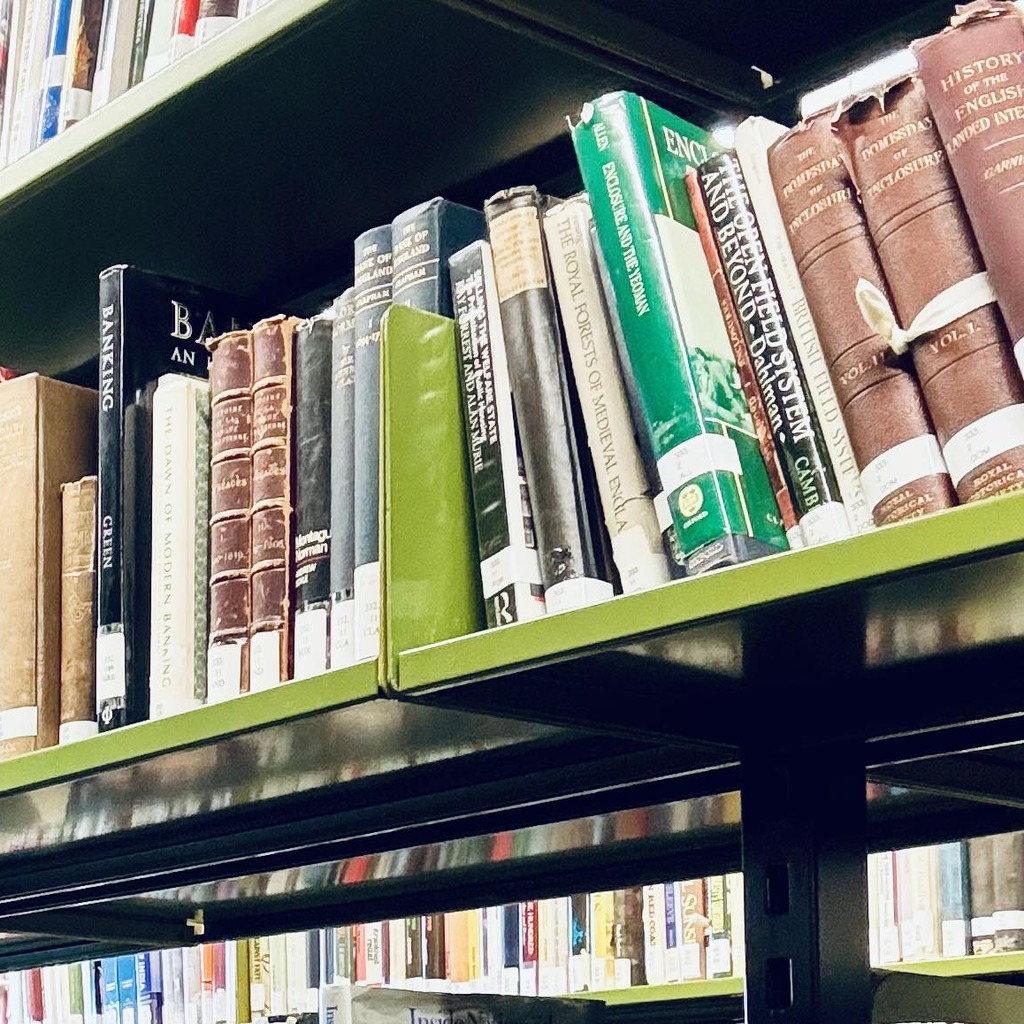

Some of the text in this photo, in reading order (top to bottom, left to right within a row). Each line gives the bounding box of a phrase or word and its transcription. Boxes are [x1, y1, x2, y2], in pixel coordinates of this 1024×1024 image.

[940, 51, 1023, 92] HISTORY
[964, 73, 1009, 95] OF THE
[861, 116, 933, 162] DOMESDAY
[880, 109, 900, 126] THE
[945, 116, 991, 153] LANDED
[867, 150, 943, 198] INCLOSURE
[873, 147, 889, 160] OF
[414, 229, 429, 241] OF
[592, 121, 651, 316] ALLEN ENCLOSURE AND THE YEOMAN
[377, 251, 392, 265] OF
[731, 209, 768, 274] OPEN
[749, 274, 789, 349] FIELD
[170, 346, 196, 367] AN
[702, 172, 729, 223] AND
[717, 225, 757, 321] BEYOND
[750, 336, 783, 431] Dahlman
[788, 454, 824, 507] CAMB
[790, 296, 840, 422] BRITISH FIELD
[463, 362, 475, 392] AND
[480, 347, 495, 403] WELFARE
[558, 218, 628, 531] THE ROYAL FORESTS OF MEDIEVAL ENGLA
[768, 346, 815, 441] SYSTEM
[466, 393, 479, 429] ALAN
[485, 404, 498, 444] STATE
[102, 303, 114, 569] BANKING GREEN
[468, 430, 483, 472] MURIE
[973, 462, 1013, 488] ROYAL
[161, 406, 172, 688] THE DAWN OF MODERN BANKING
[681, 893, 698, 942] SUNS
